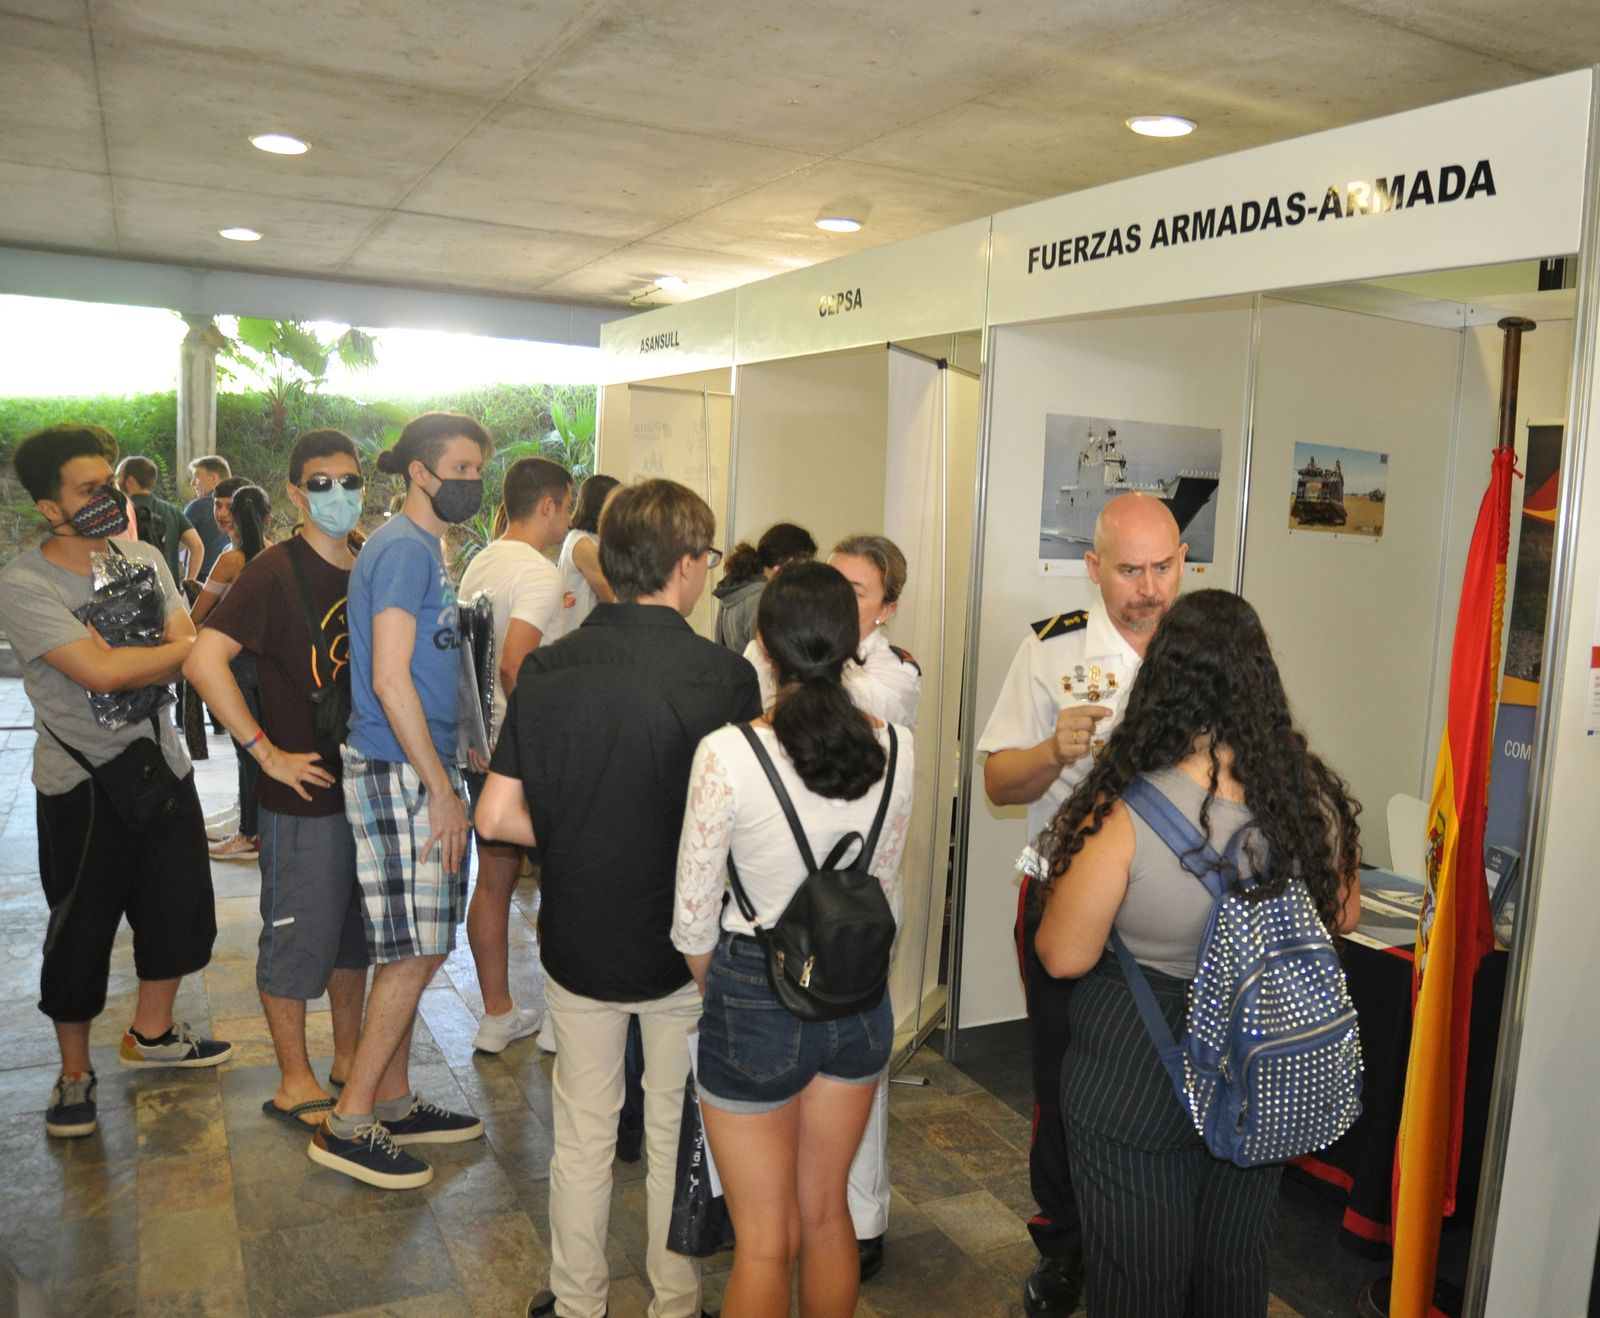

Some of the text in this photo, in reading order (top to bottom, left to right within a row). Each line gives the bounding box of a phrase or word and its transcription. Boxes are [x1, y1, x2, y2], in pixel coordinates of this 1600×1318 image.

[1027, 159, 1497, 275] FUERZAS ARMADAS-ARMADA
[818, 287, 863, 318] CEPSA
[640, 330, 680, 354] ASANSULL
